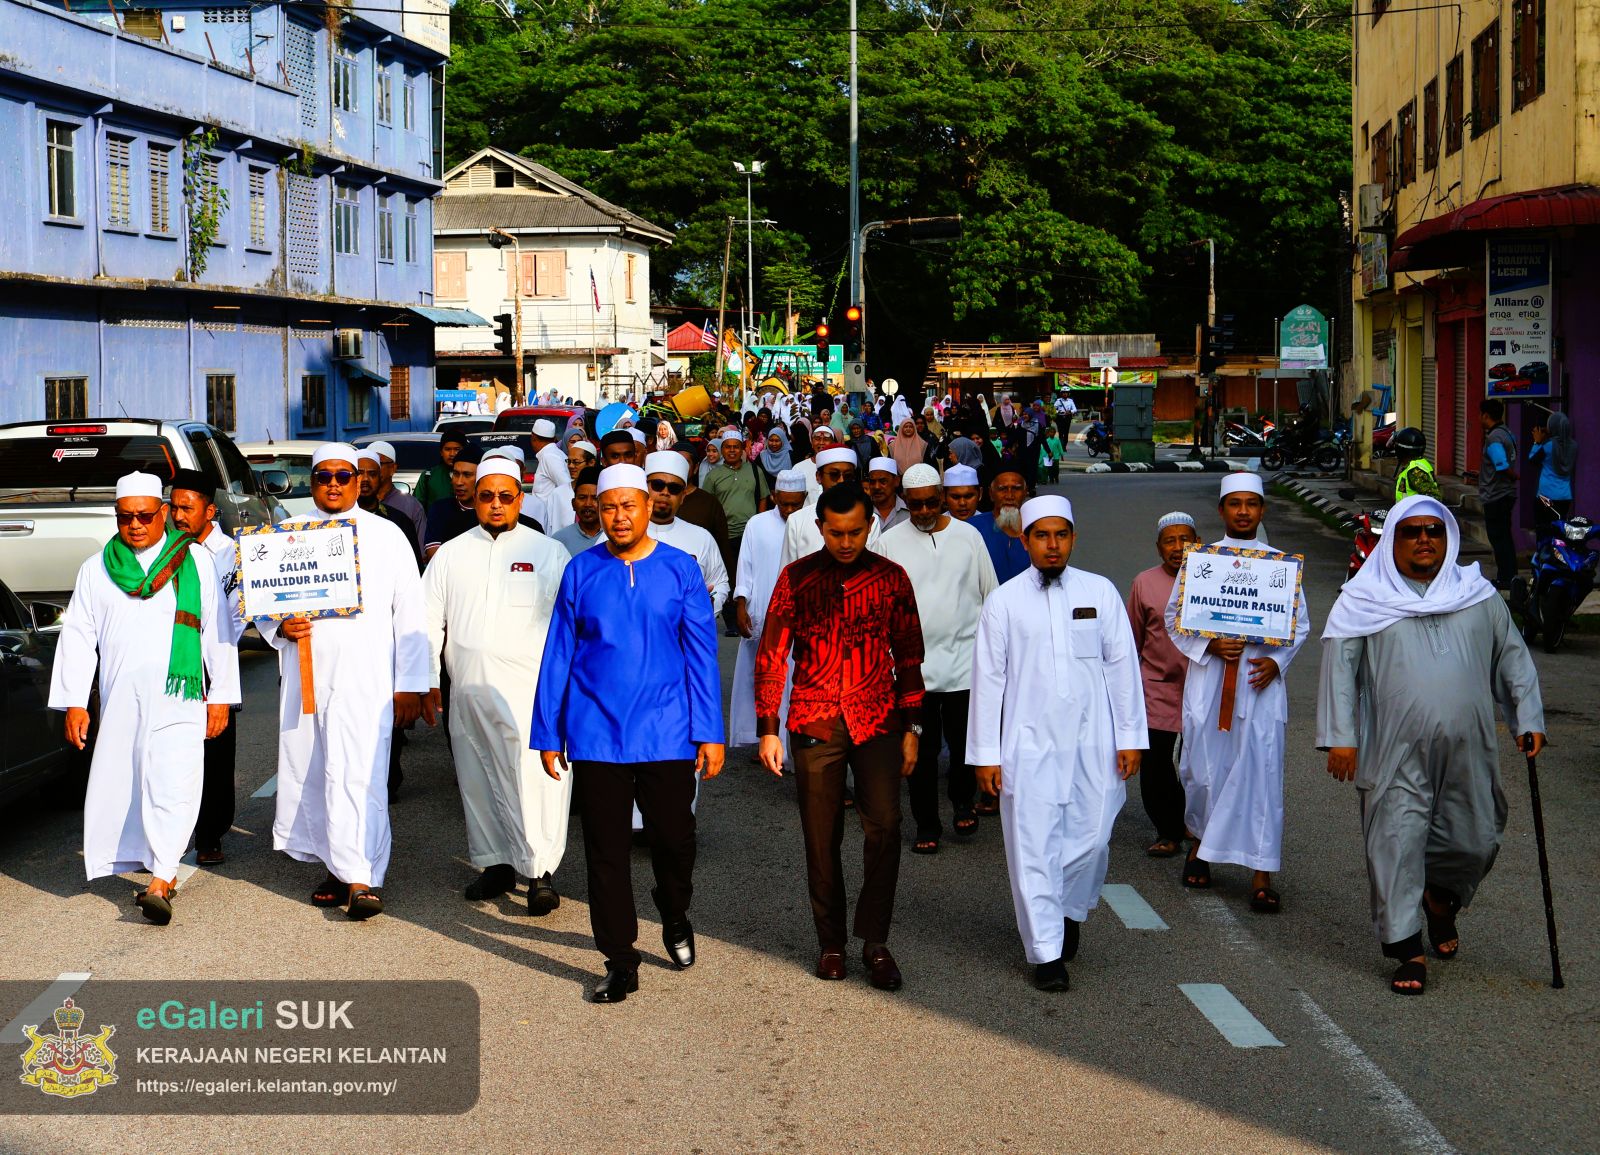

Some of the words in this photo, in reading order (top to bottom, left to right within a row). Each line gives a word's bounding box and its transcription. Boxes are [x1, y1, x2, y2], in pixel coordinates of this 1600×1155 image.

[1497, 256, 1541, 265] ROADTAX
[1497, 267, 1528, 277] LESEN
[1494, 297, 1529, 306] Allianz
[279, 561, 318, 573] SALAM
[251, 575, 311, 589] MAULIDUR
[313, 572, 349, 584] RASUL
[1220, 585, 1258, 597] SALAM
[1190, 595, 1249, 609] MAULIDUR
[1251, 602, 1286, 613] RASUL
